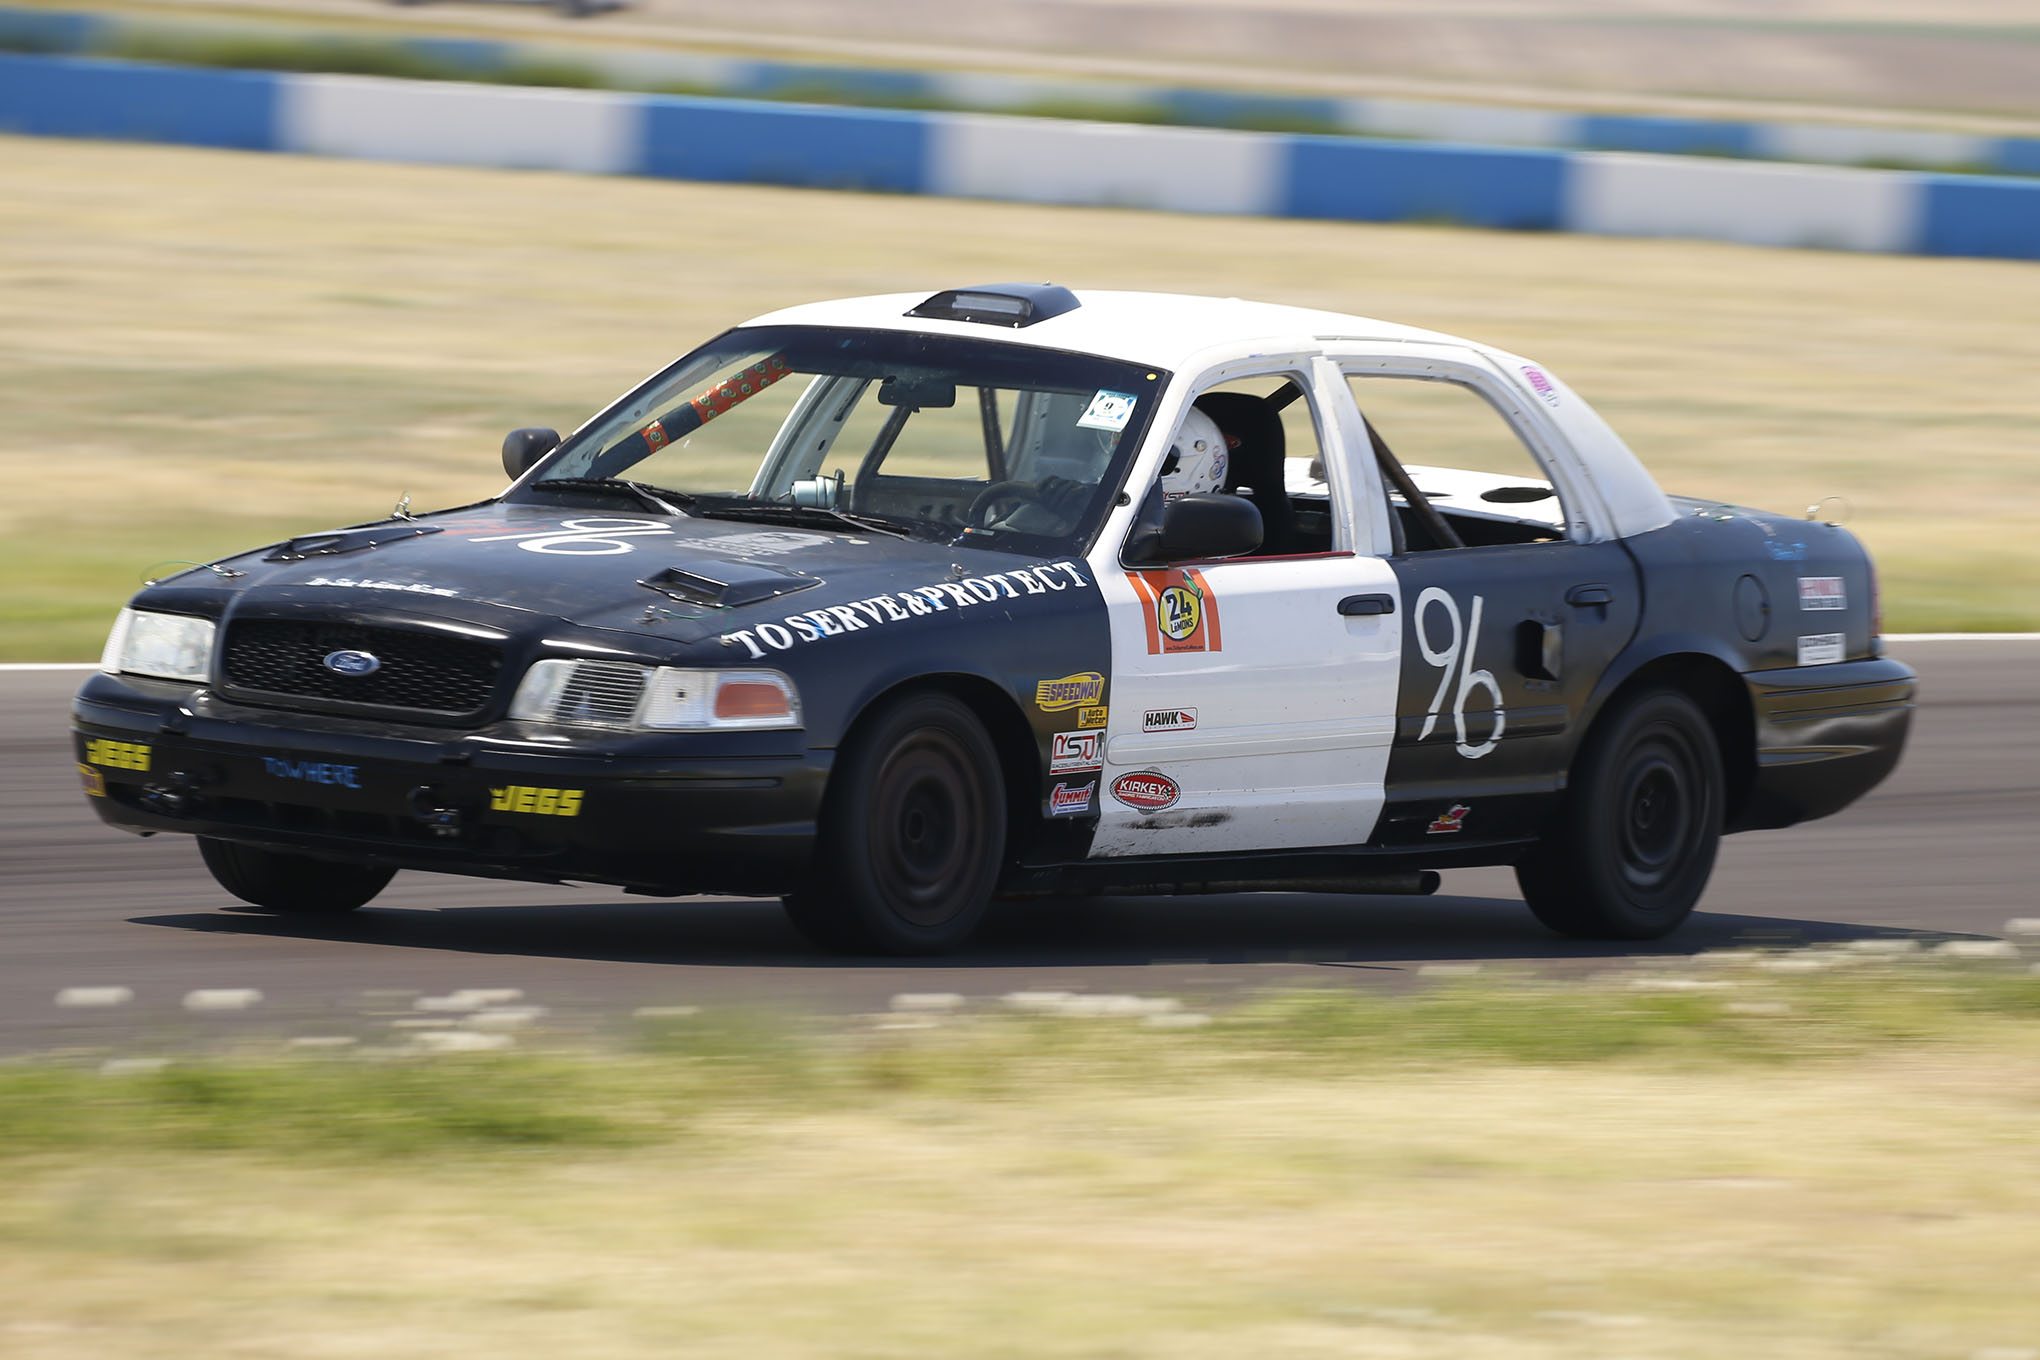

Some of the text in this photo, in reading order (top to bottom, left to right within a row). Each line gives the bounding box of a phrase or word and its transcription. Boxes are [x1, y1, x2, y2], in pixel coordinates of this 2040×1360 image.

[1165, 590, 1193, 621] 24
[1413, 586, 1506, 759] 96
[1049, 681, 1101, 702] SPEEDWAY
[1145, 711, 1180, 727] HAWK
[86, 738, 152, 772] JEGS
[488, 785, 585, 816] JEGS
[1119, 779, 1167, 796] KIRKEY
